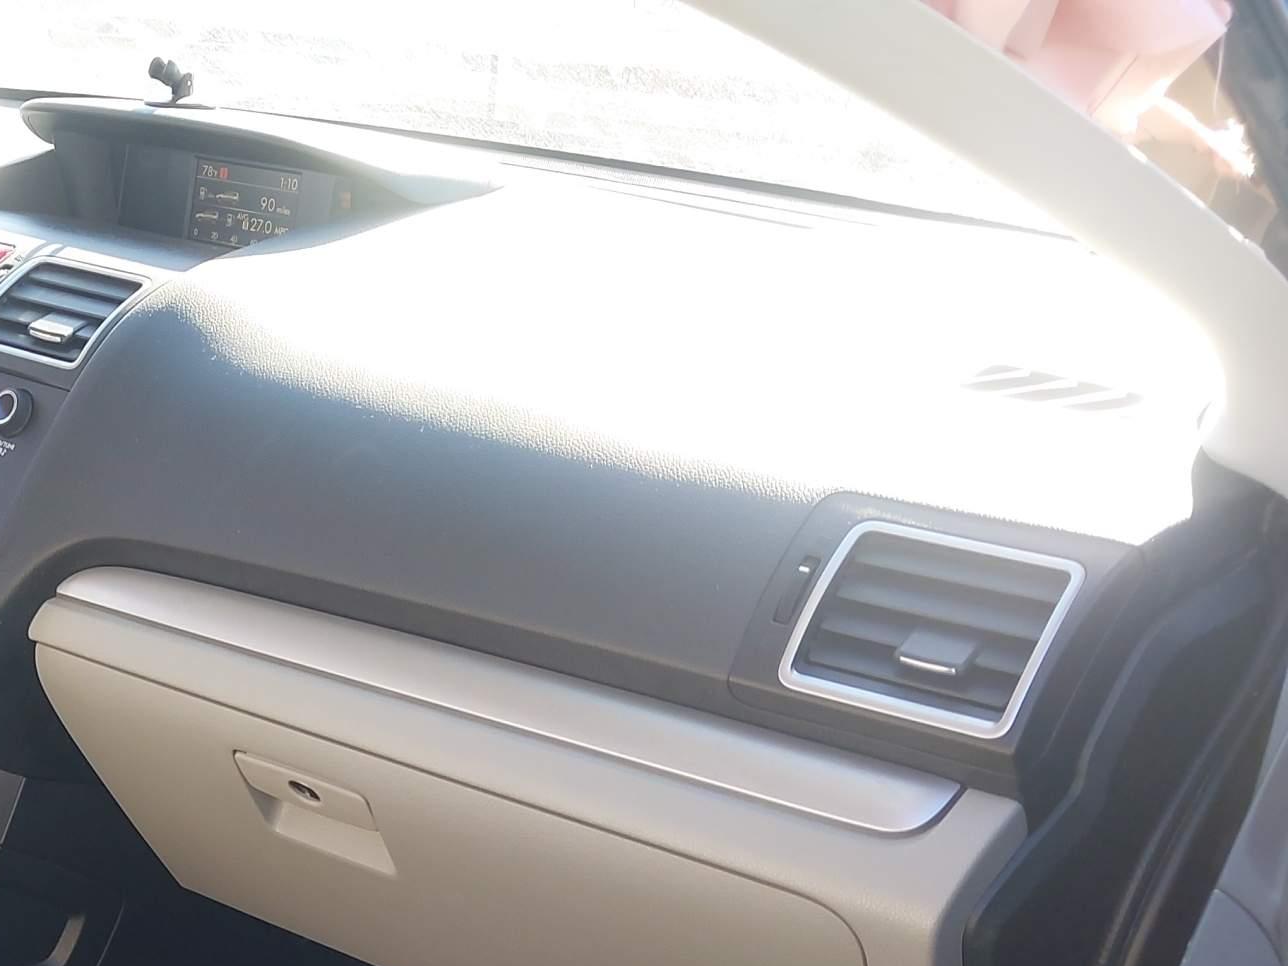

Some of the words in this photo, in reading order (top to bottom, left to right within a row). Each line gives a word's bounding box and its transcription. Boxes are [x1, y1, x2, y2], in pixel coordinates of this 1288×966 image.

[280, 176, 298, 191] 1:10
[260, 196, 276, 212] 90
[250, 218, 272, 234] 27.0
